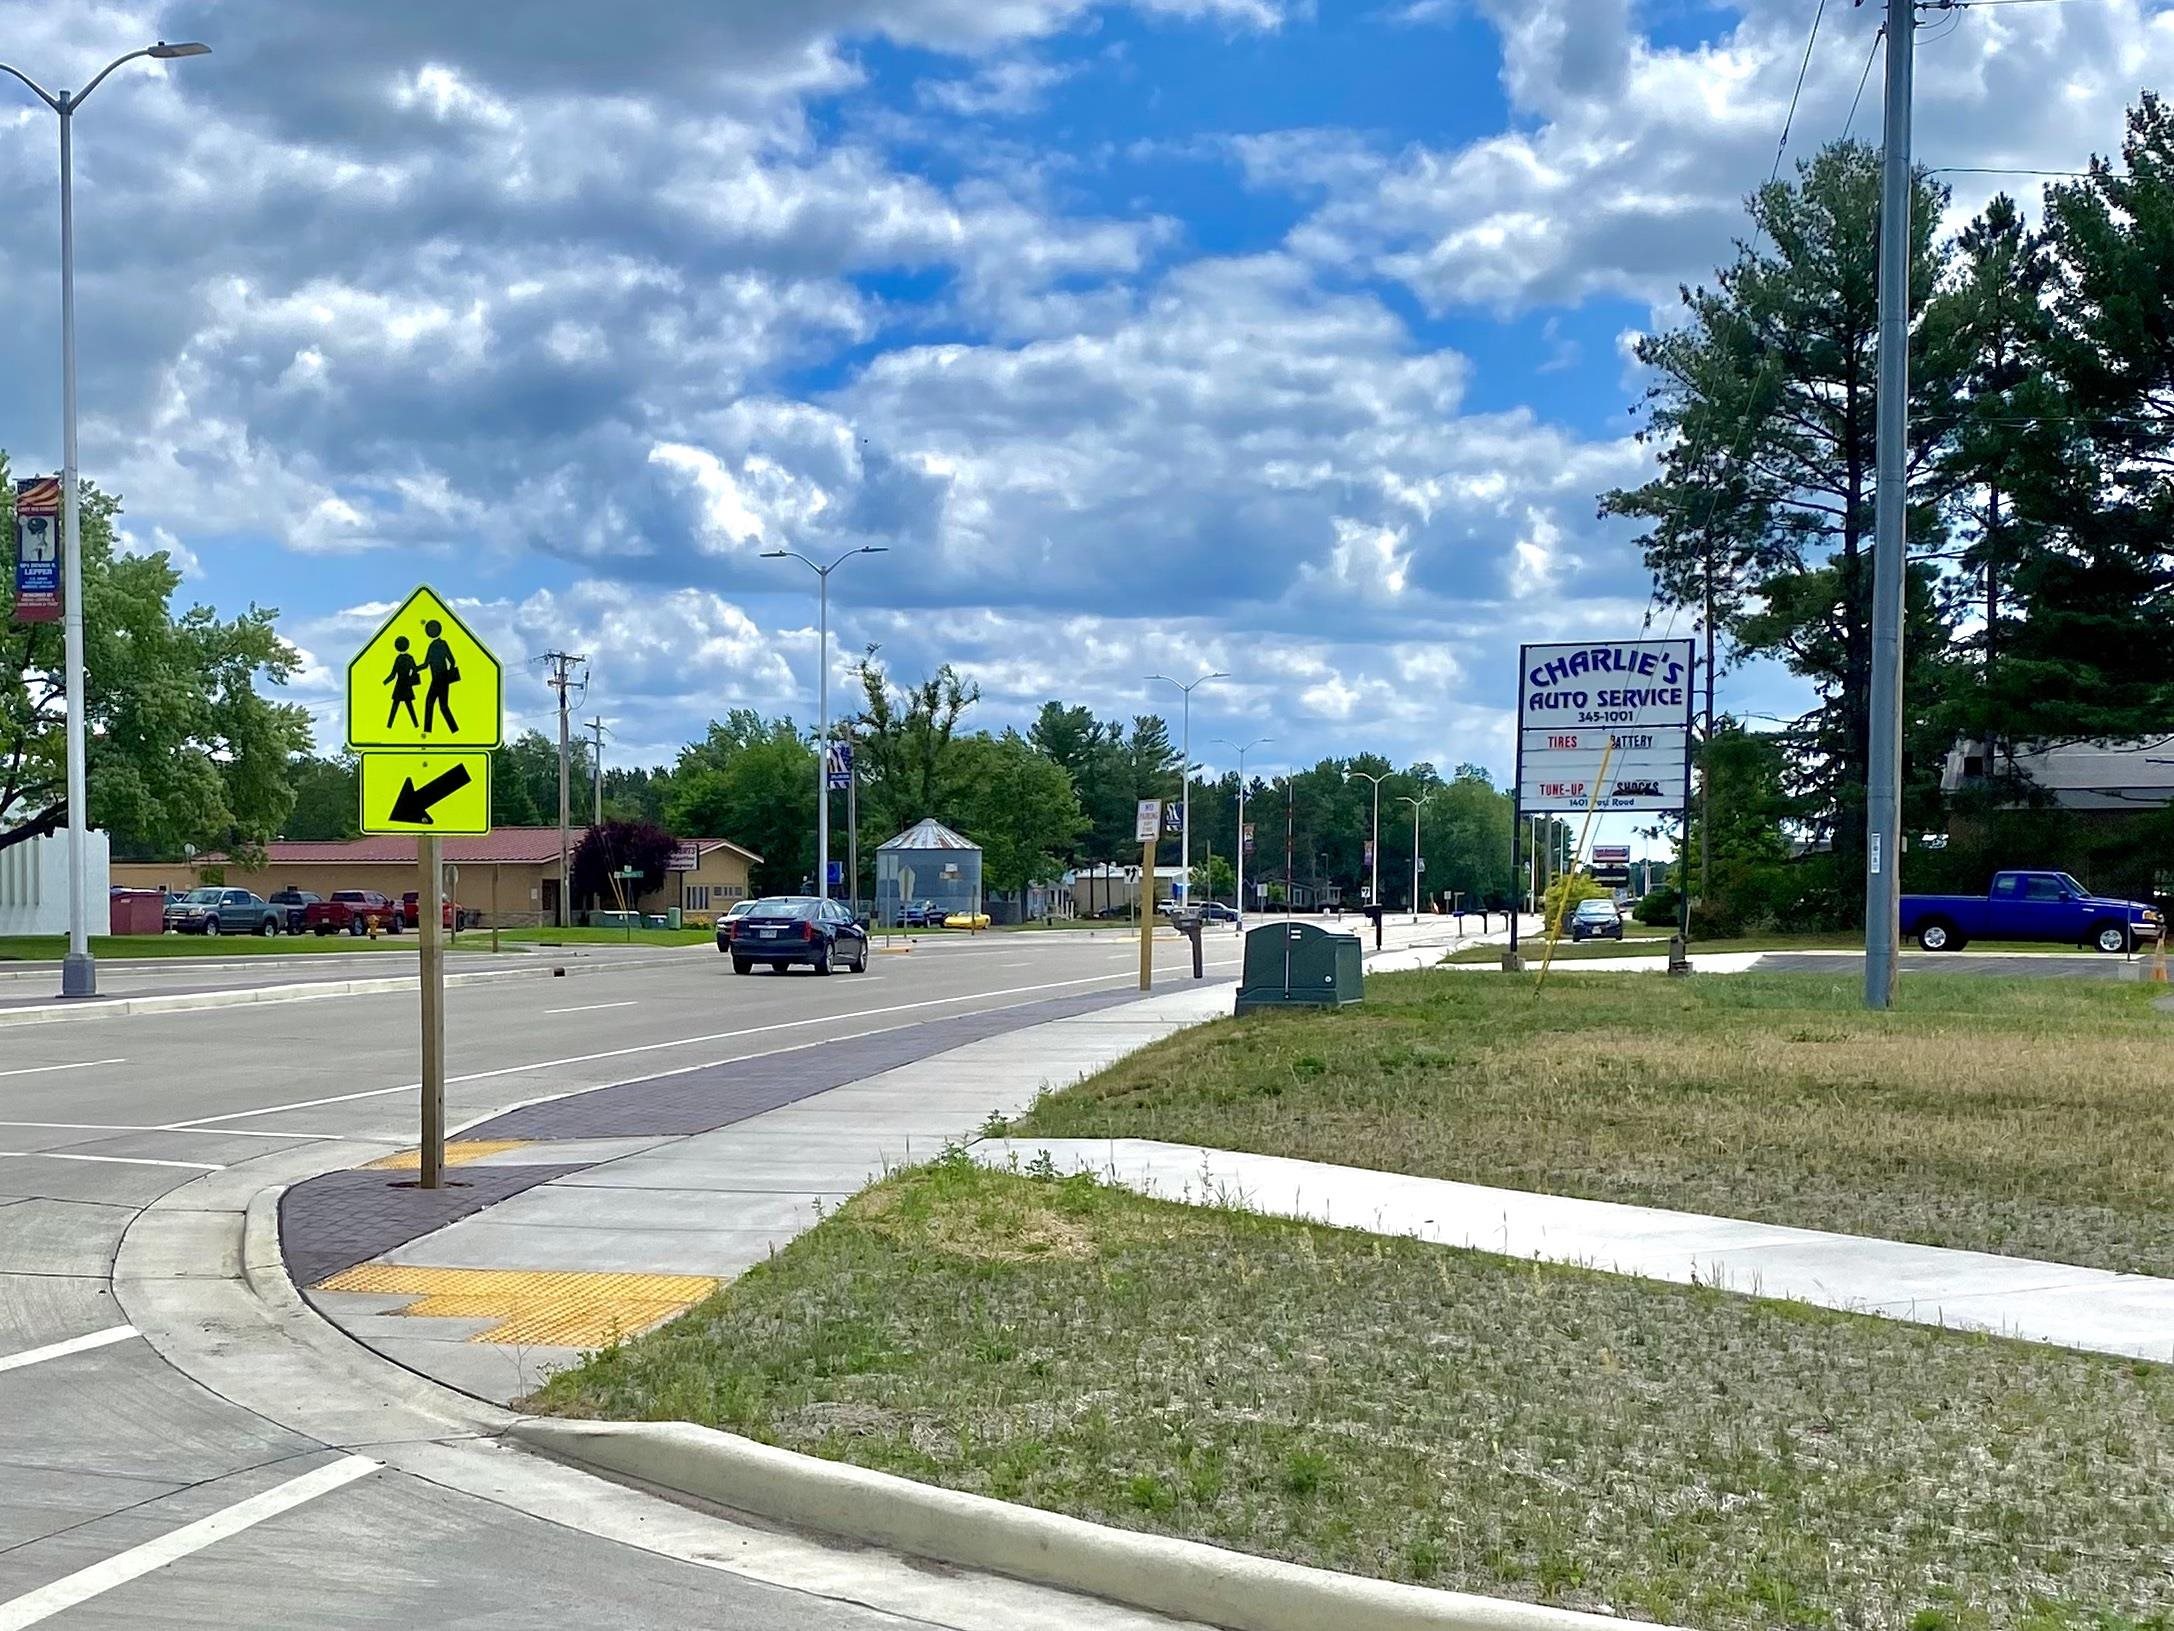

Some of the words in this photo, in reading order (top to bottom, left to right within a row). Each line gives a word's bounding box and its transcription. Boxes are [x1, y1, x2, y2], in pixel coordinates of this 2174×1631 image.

[1529, 648, 1685, 687] CHARLIE'S
[1529, 691, 1588, 711] AUTO
[1597, 688, 1683, 709] SERVICE
[1578, 710, 1633, 722] 345-1001
[1548, 735, 1577, 748] TIRES
[1610, 735, 1653, 750] BATTERY
[1540, 783, 1584, 796] TUNE-UP
[1569, 799, 1588, 807] 1401
[1612, 798, 1634, 807] Road
